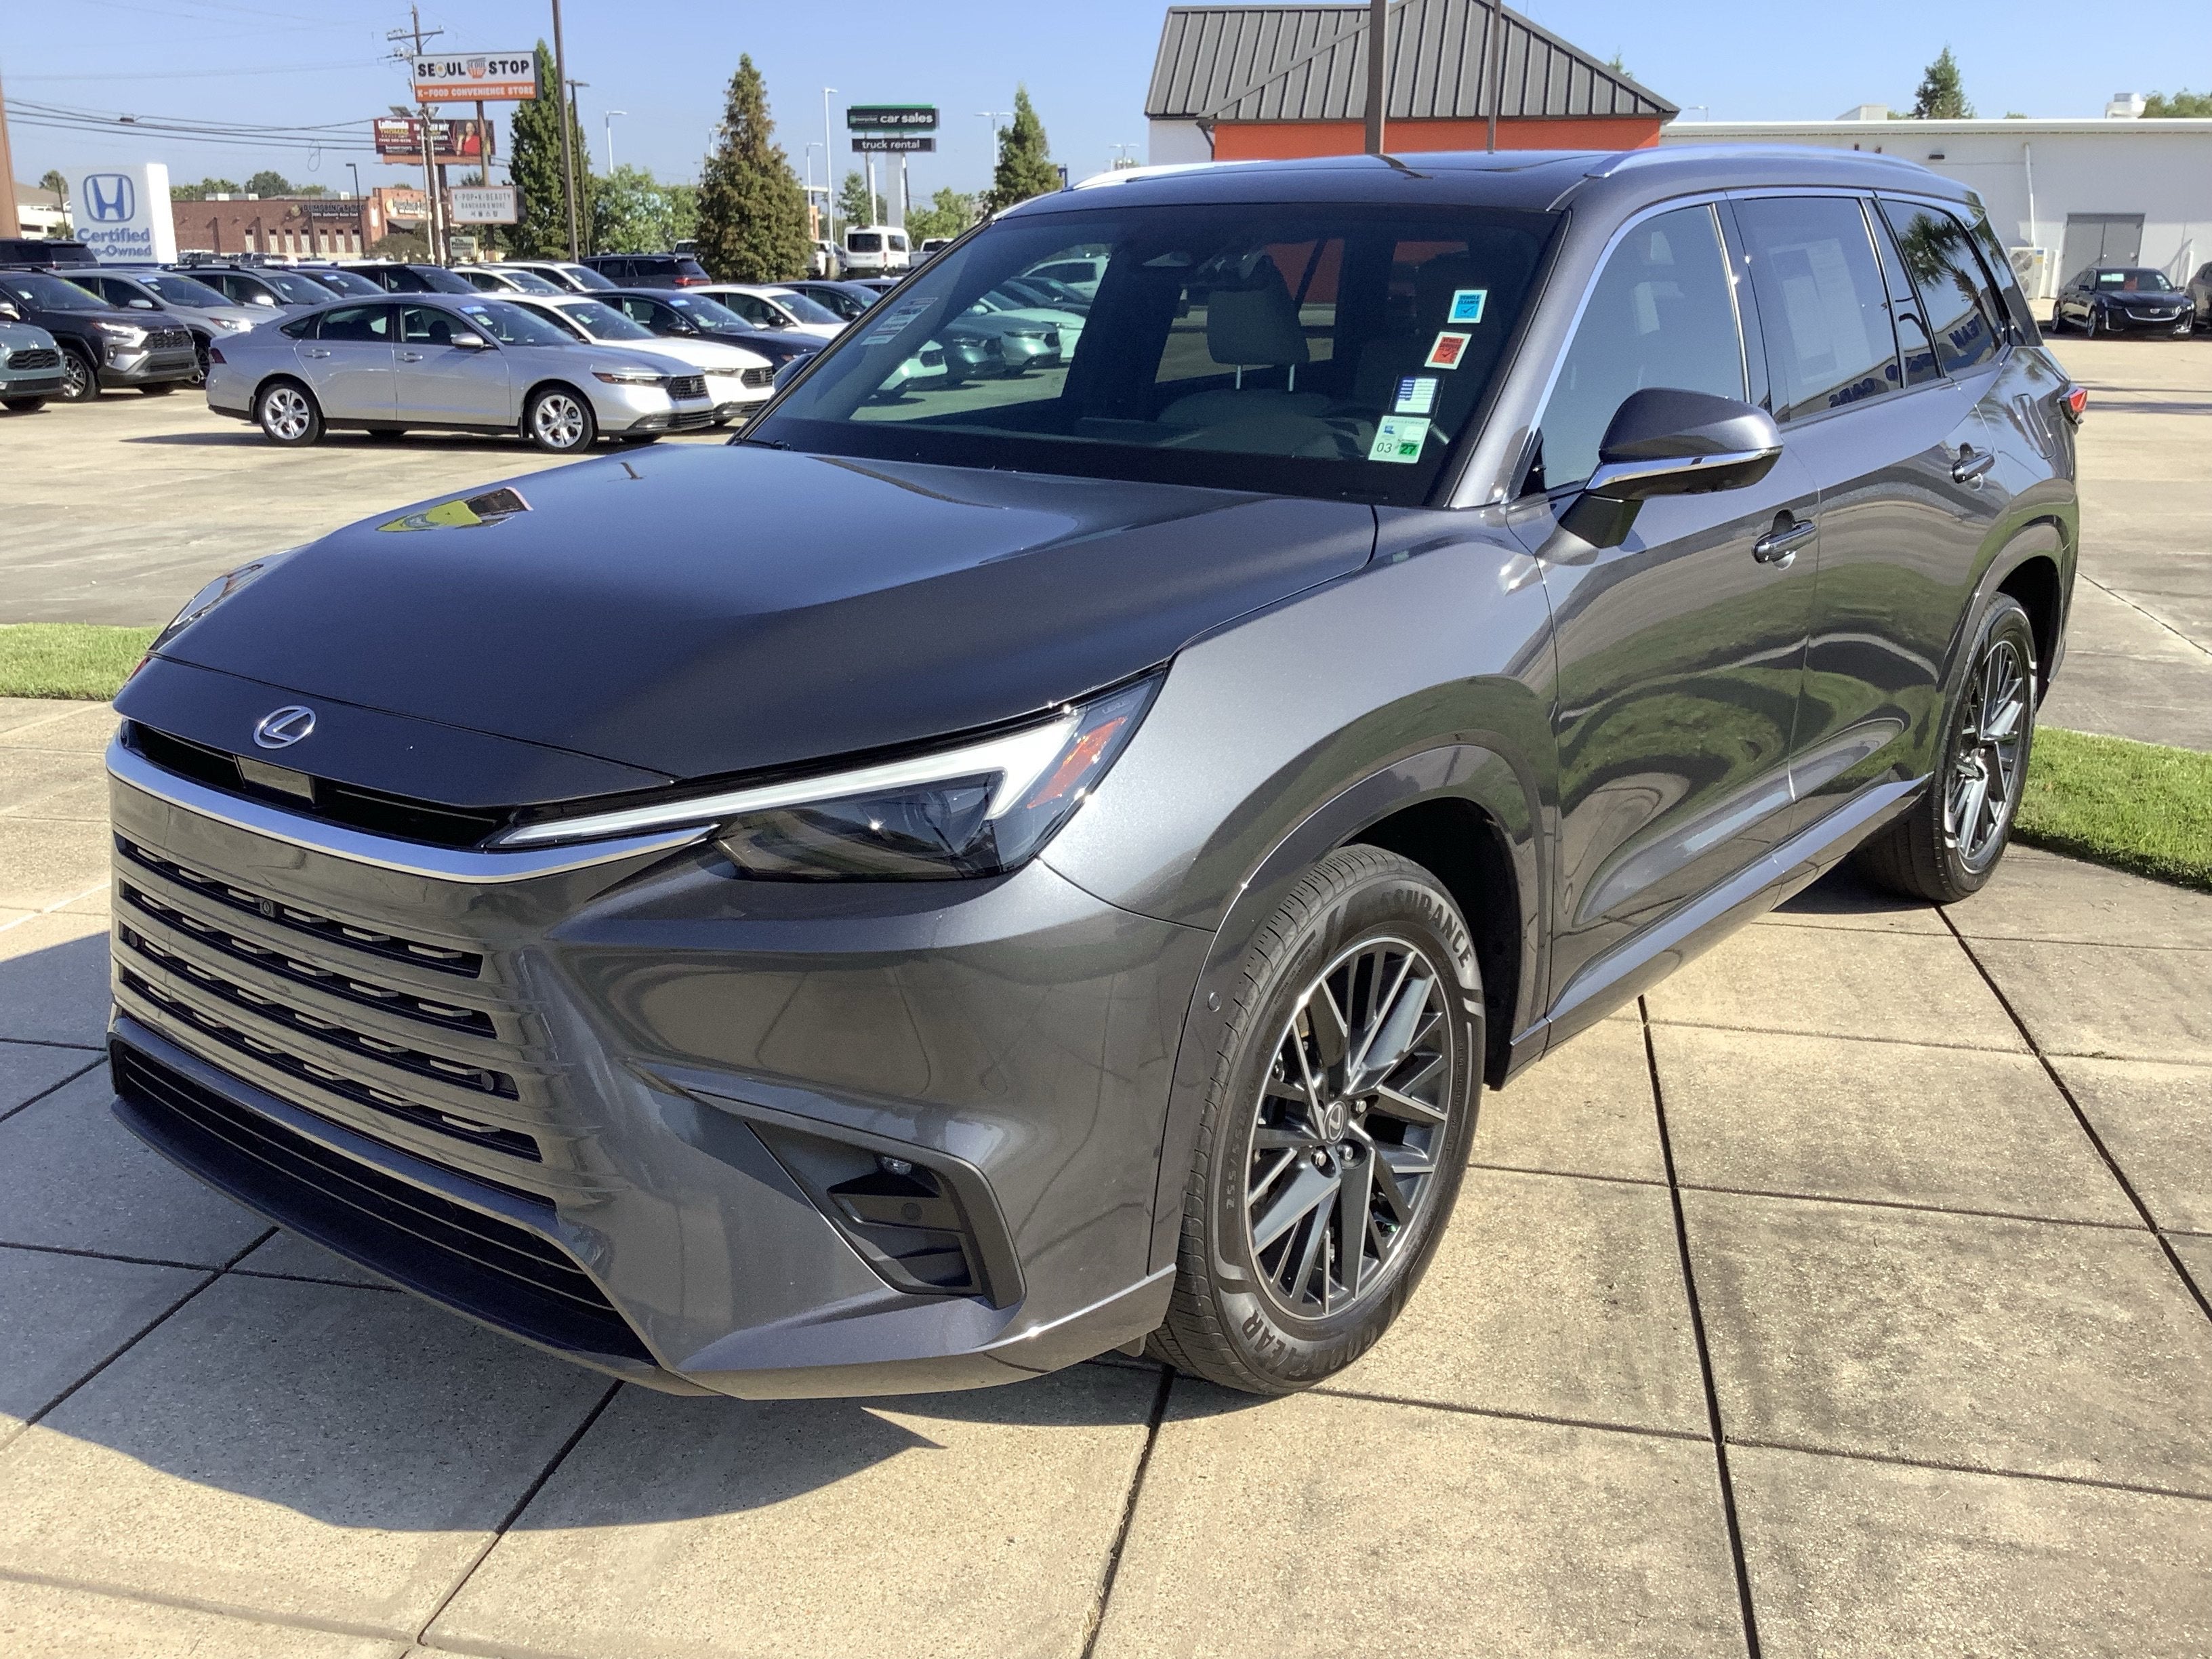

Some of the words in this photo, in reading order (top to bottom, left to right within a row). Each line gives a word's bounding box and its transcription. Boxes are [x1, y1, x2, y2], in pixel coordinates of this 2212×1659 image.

[417, 62, 466, 78] SEOUL
[488, 60, 530, 75] STOP
[417, 89, 449, 98] K-FOOD
[451, 87, 506, 97] CONVENIENCE
[508, 85, 534, 96] STORE
[880, 115, 900, 123] car
[901, 112, 933, 123] sales
[861, 139, 888, 149] truck
[890, 139, 920, 149] rental
[77, 227, 150, 243] Certified
[91, 244, 152, 257] e-Owned
[1376, 442, 1393, 453] 03
[1399, 443, 1418, 455] 27
[1364, 888, 1472, 969] SSURANCE
